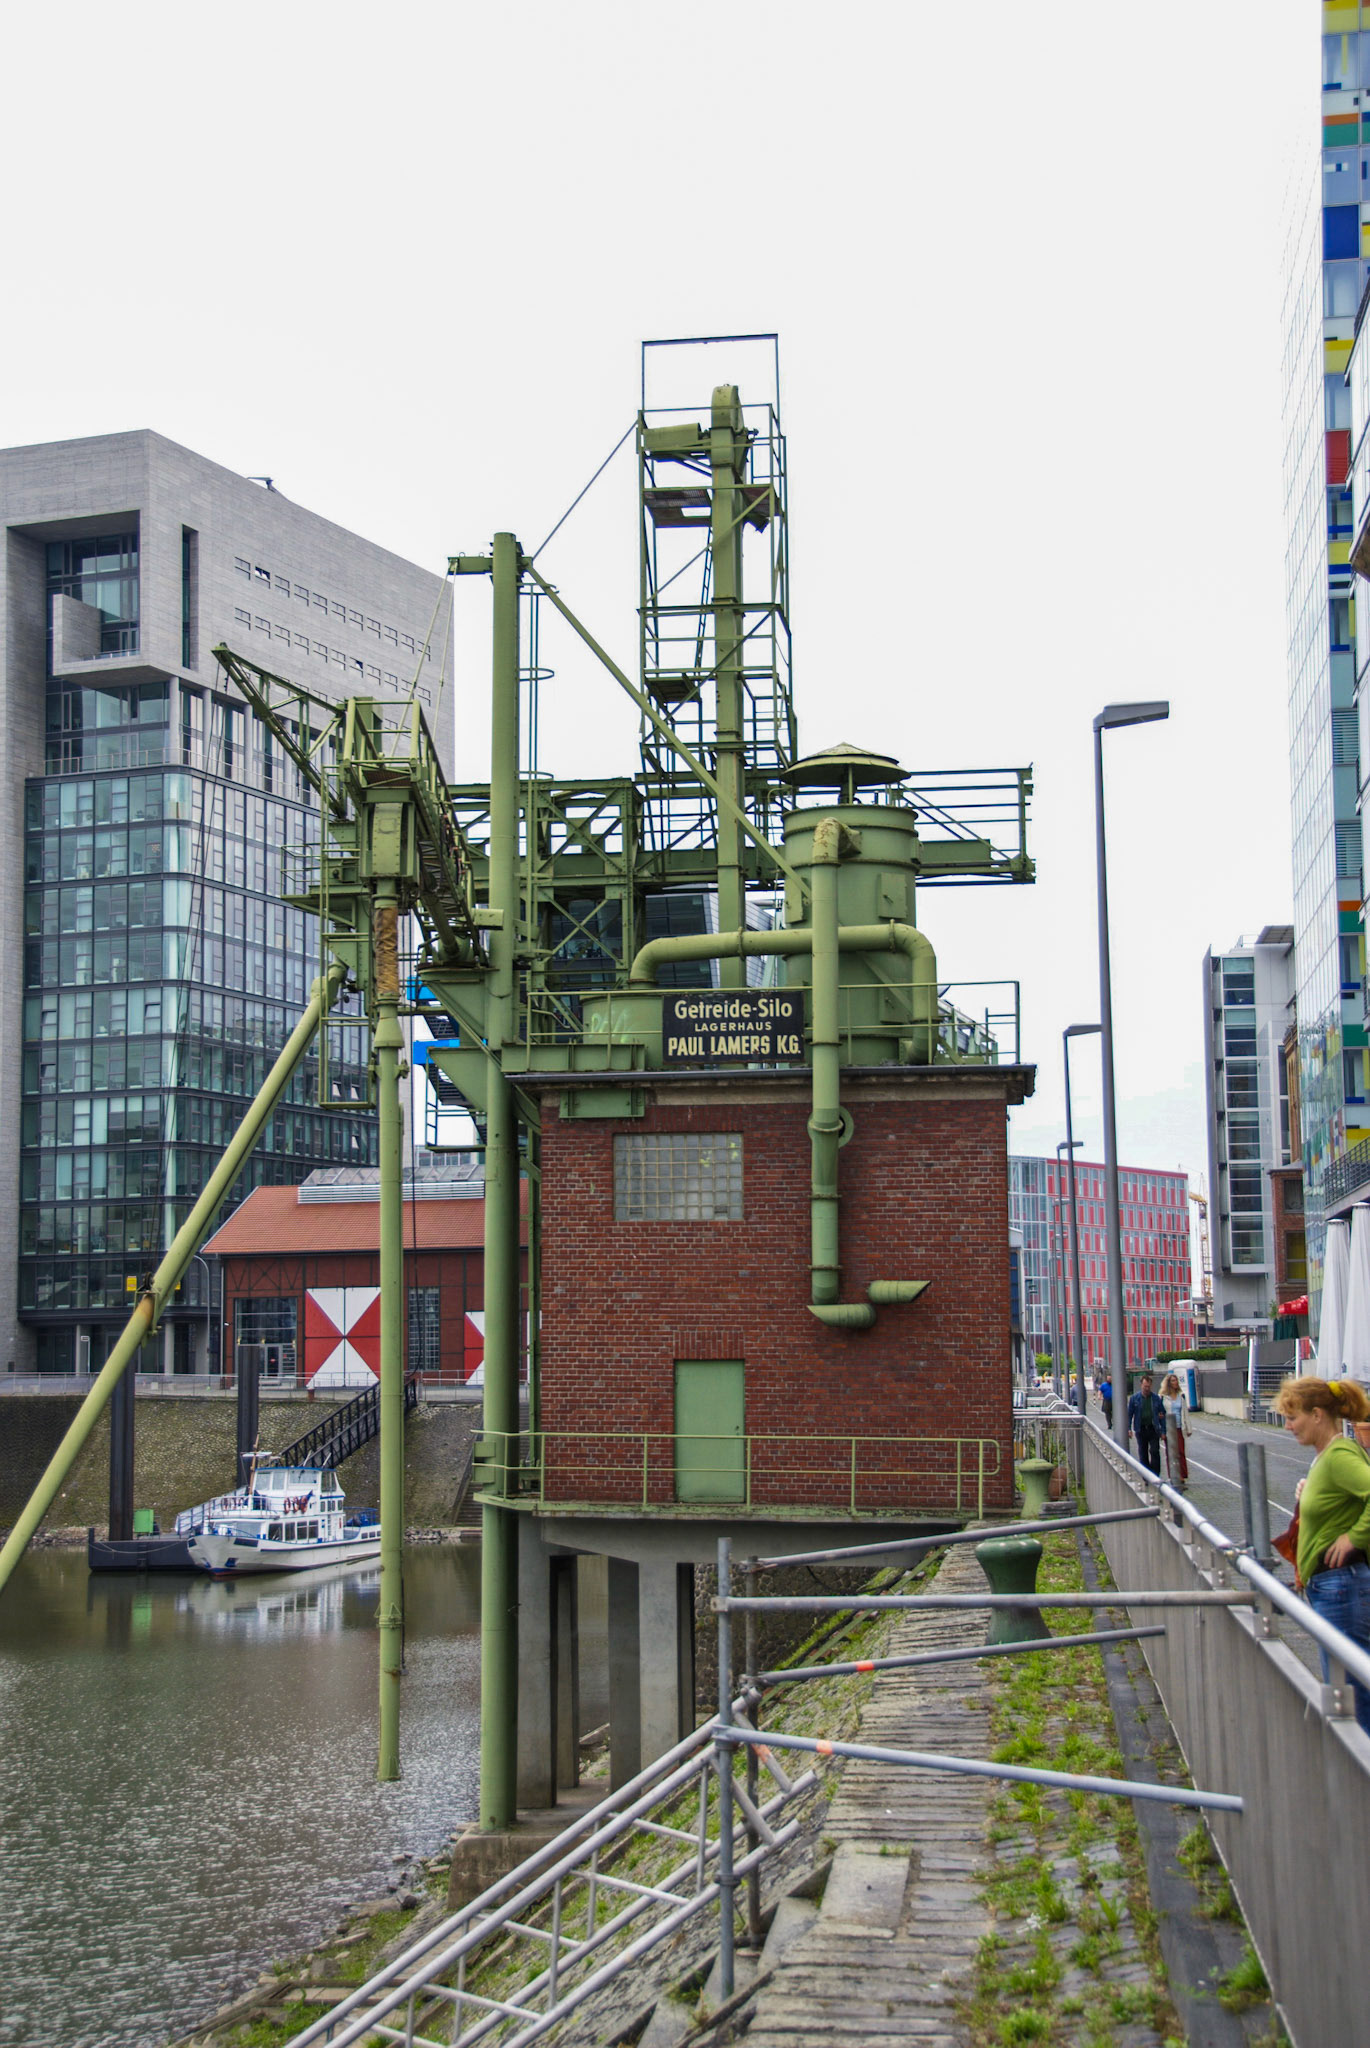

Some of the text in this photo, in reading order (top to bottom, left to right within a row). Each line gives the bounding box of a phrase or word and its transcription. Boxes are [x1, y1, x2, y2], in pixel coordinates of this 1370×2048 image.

[674, 998, 793, 1019] Getreide-Silo
[694, 1021, 773, 1032] LAGERHAUS
[668, 1036, 705, 1056] PAUL
[711, 1035, 771, 1056] LAMERS
